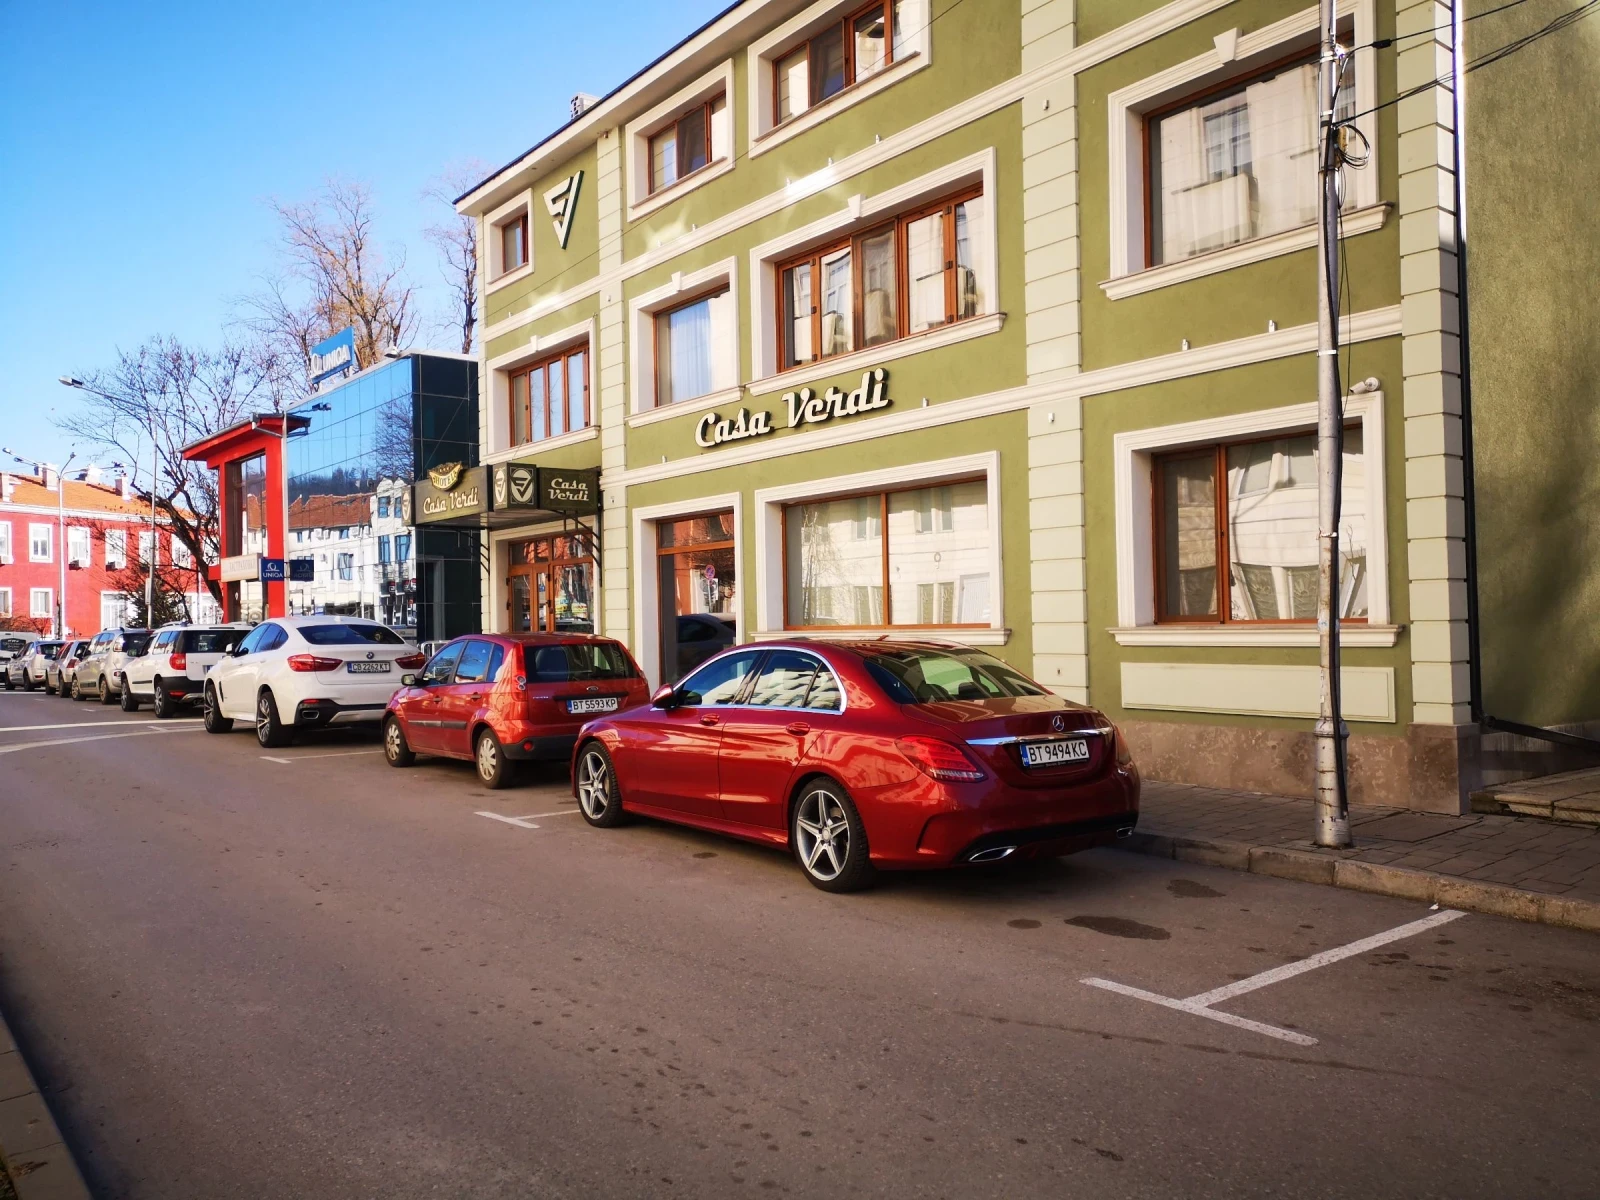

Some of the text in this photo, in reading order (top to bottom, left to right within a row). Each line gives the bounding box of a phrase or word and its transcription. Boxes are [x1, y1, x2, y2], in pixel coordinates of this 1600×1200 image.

[323, 344, 351, 371] UNIQA
[695, 367, 891, 448] Casa Verdi
[434, 472, 457, 487] HOTEL
[551, 478, 588, 490] Casa
[423, 487, 479, 514] Casa Verdi
[548, 489, 589, 501] Verdi
